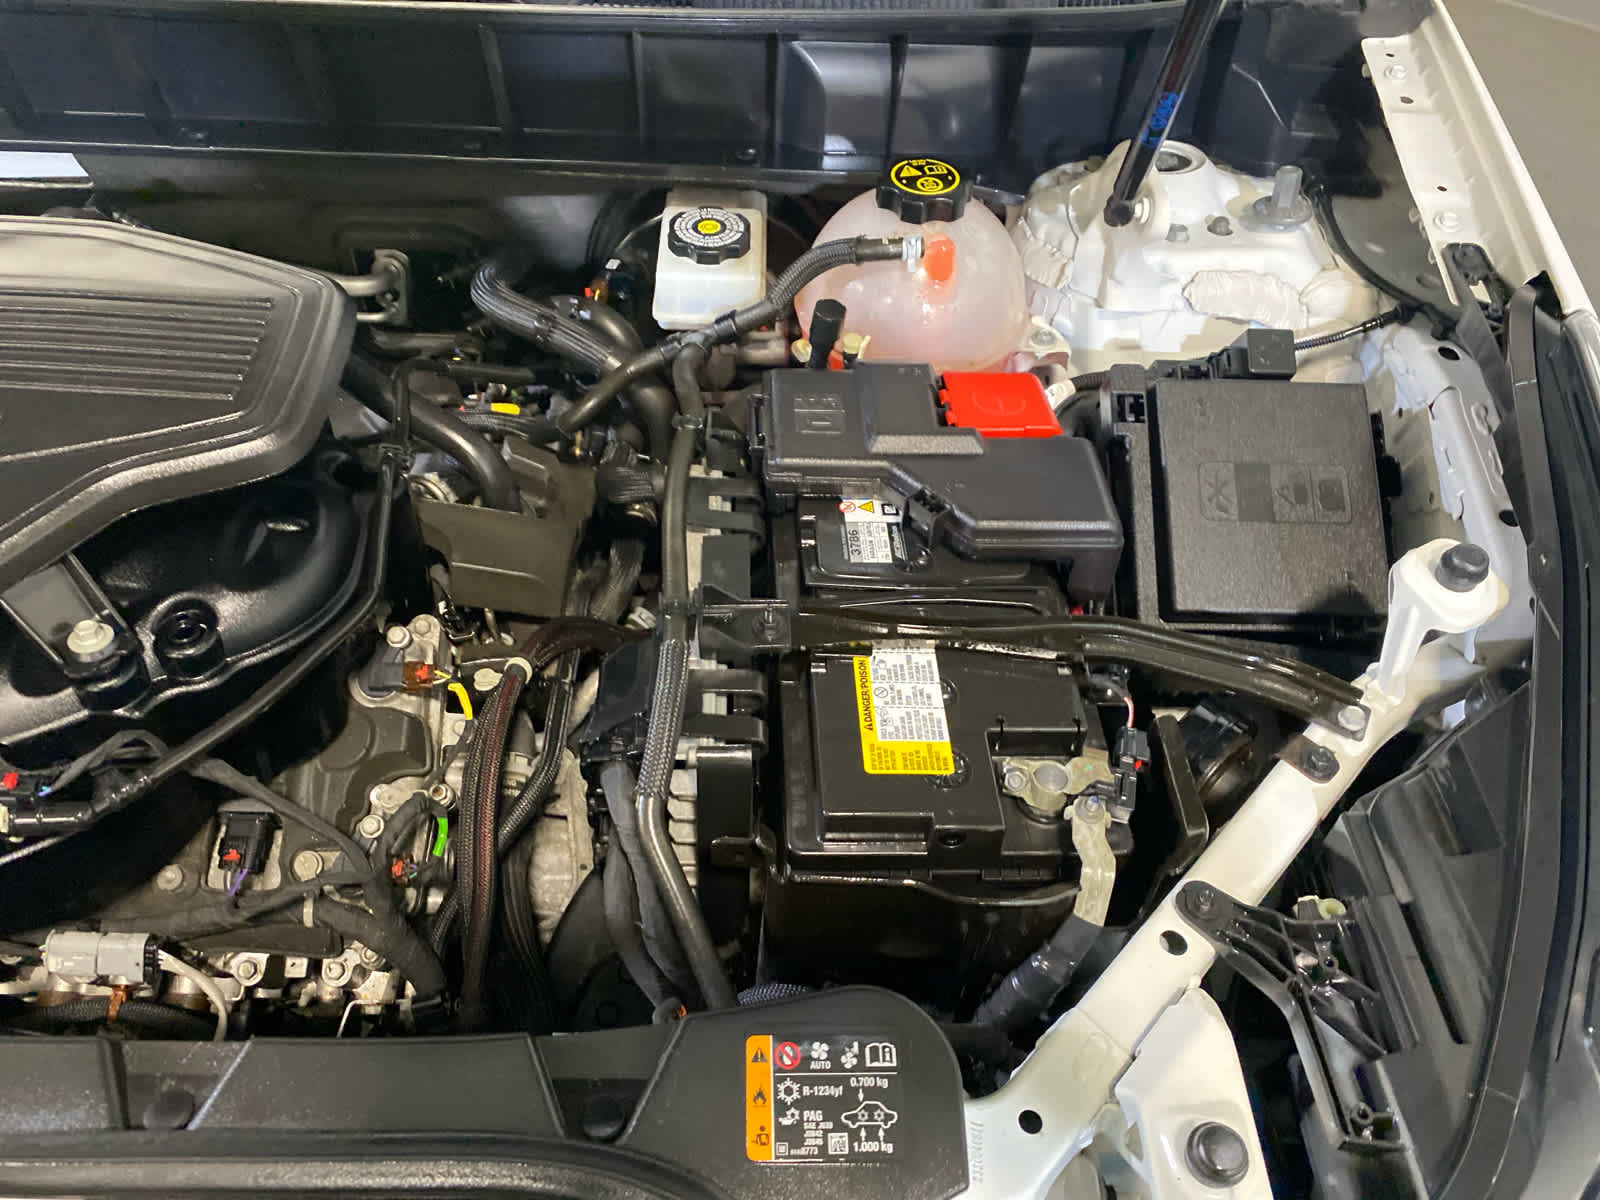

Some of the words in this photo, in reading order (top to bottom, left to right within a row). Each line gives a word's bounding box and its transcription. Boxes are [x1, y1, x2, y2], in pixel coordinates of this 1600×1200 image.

[848, 529, 861, 556] 3786
[810, 1060, 831, 1070] AUTO
[850, 1077, 875, 1087] 0.700
[876, 1076, 888, 1089] kg
[802, 1086, 843, 1098] R-1234yf
[803, 1111, 823, 1121] PAG
[853, 1142, 880, 1153] 1.000
[880, 1141, 893, 1154] kg
